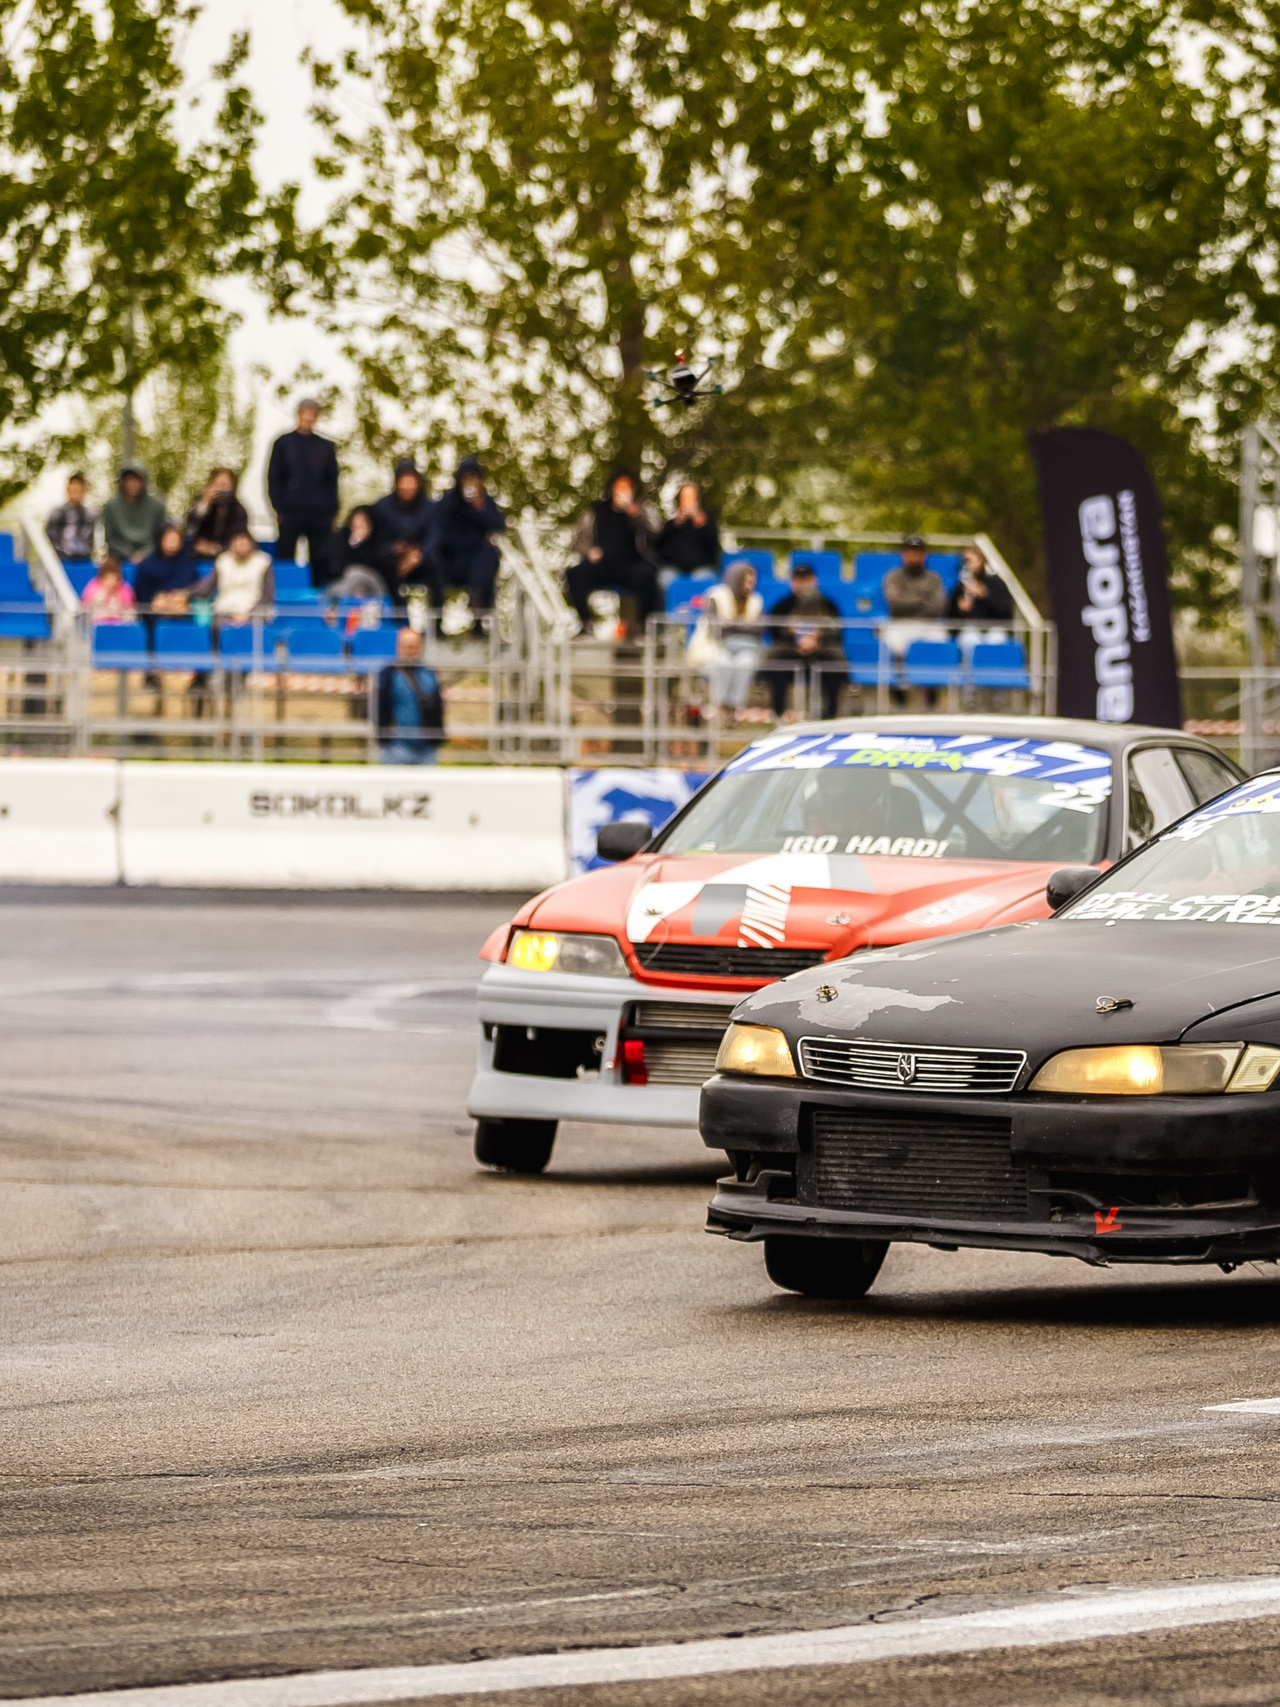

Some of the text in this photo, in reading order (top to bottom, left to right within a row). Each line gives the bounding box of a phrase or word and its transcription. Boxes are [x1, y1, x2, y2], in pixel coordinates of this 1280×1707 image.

[1078, 494, 1134, 723] andora
[1037, 782, 1109, 814] 22
[845, 834, 950, 858] HARD!
